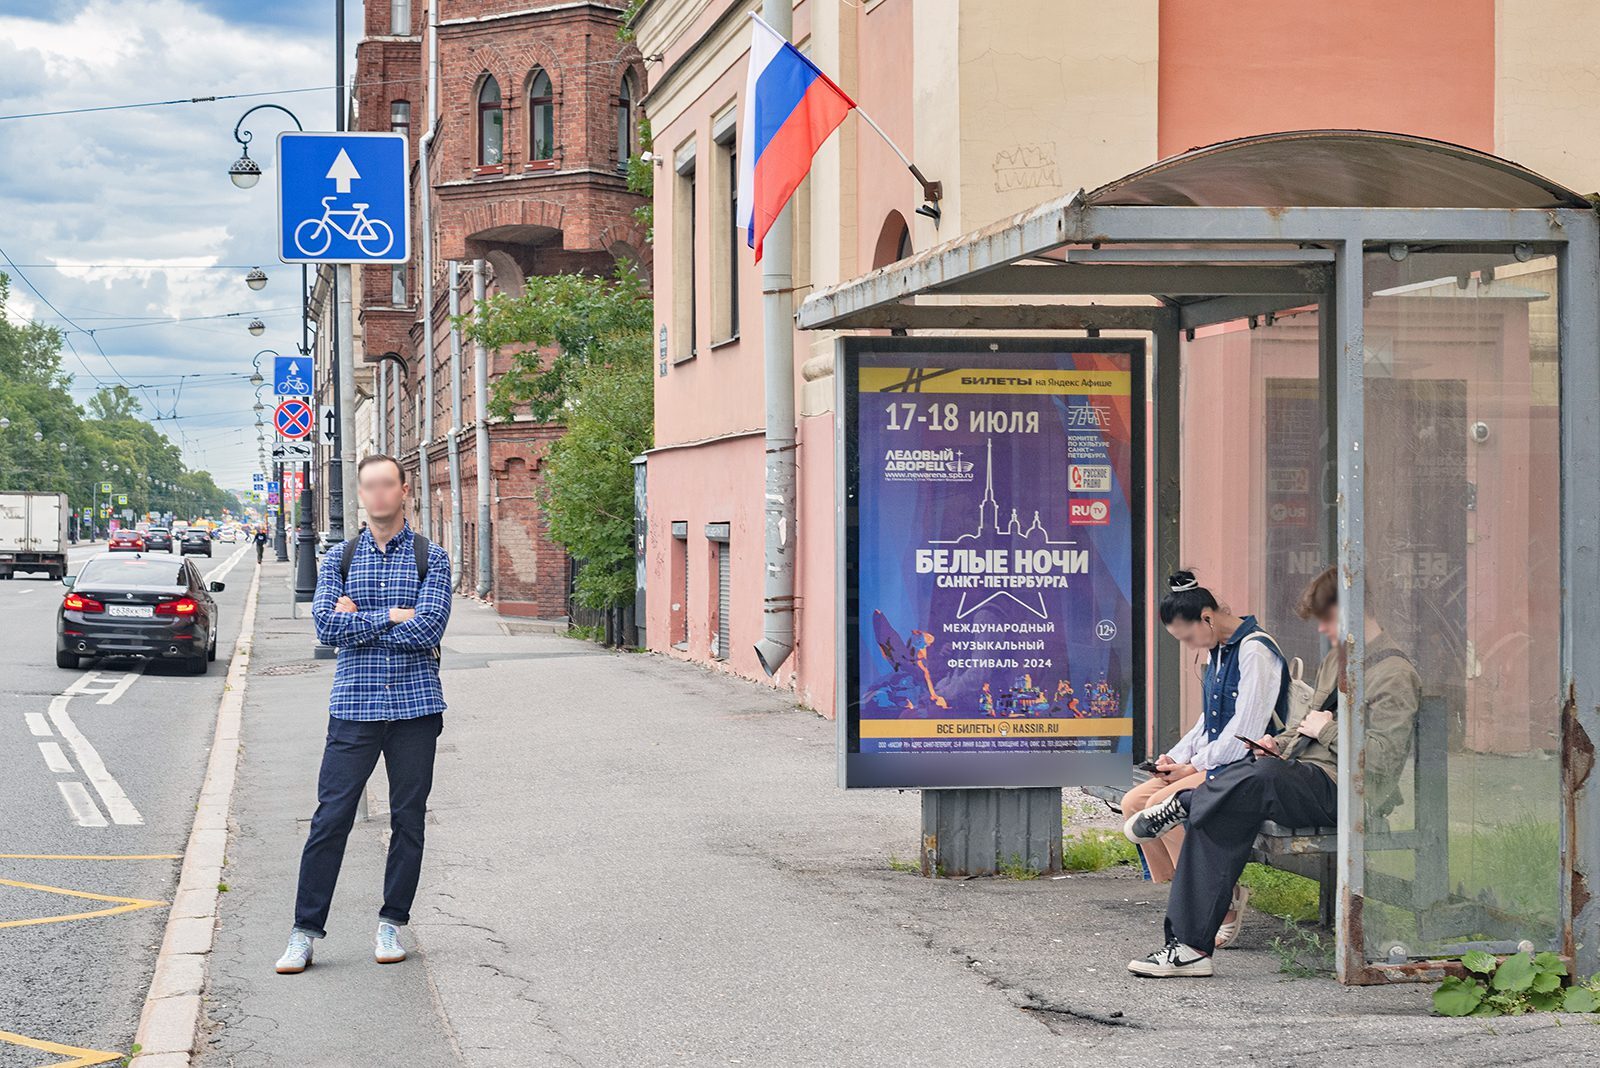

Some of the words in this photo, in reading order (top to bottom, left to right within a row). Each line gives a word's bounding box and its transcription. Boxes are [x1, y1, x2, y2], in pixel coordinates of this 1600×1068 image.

[961, 377, 1032, 386] БИЛЕТЫ
[1048, 379, 1079, 387] Яндекс
[1081, 379, 1113, 387] Афише
[885, 402, 959, 431] 17-18
[885, 448, 954, 461] ЛЕДОВЫЙ
[885, 461, 945, 471] ДВОРЕЦ
[915, 549, 1009, 574] БЕЛЫЕ
[1014, 550, 1089, 574] НОЧИ
[936, 575, 1069, 588] САНКТ-ПЕТЕРБУРГА
[943, 622, 1055, 633] МЕЖДУНАРОДНЫЙ
[1099, 624, 1115, 636] 12+
[952, 640, 1045, 651] МУЗЫКАЛЬНЫЙ
[947, 658, 1019, 669] ФЕСТИВАЛЬ
[1023, 659, 1053, 668] 2024
[936, 724, 954, 734] ВСЕ
[957, 724, 996, 734] БИЛЕТЫ
[1012, 723, 1060, 734] KASSIR.RU
